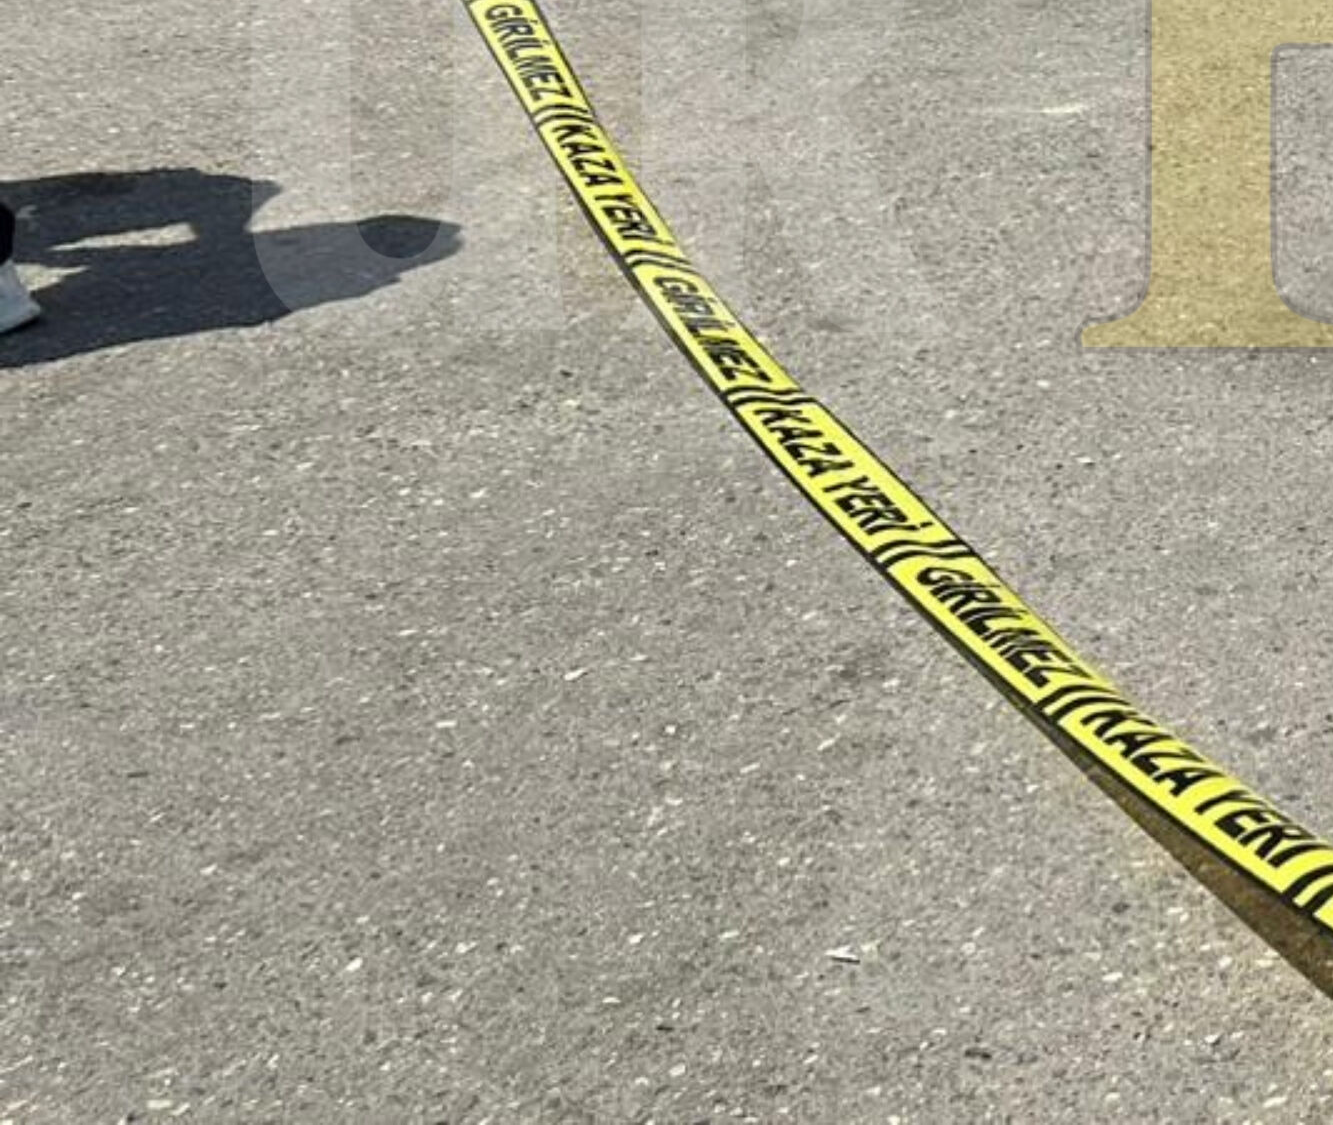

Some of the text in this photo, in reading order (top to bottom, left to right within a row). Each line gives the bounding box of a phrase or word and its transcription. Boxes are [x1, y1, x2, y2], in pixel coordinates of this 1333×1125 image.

[552, 120, 619, 189] KAZA
[753, 406, 855, 478] KAZA
[1080, 709, 1226, 797] KAZA
